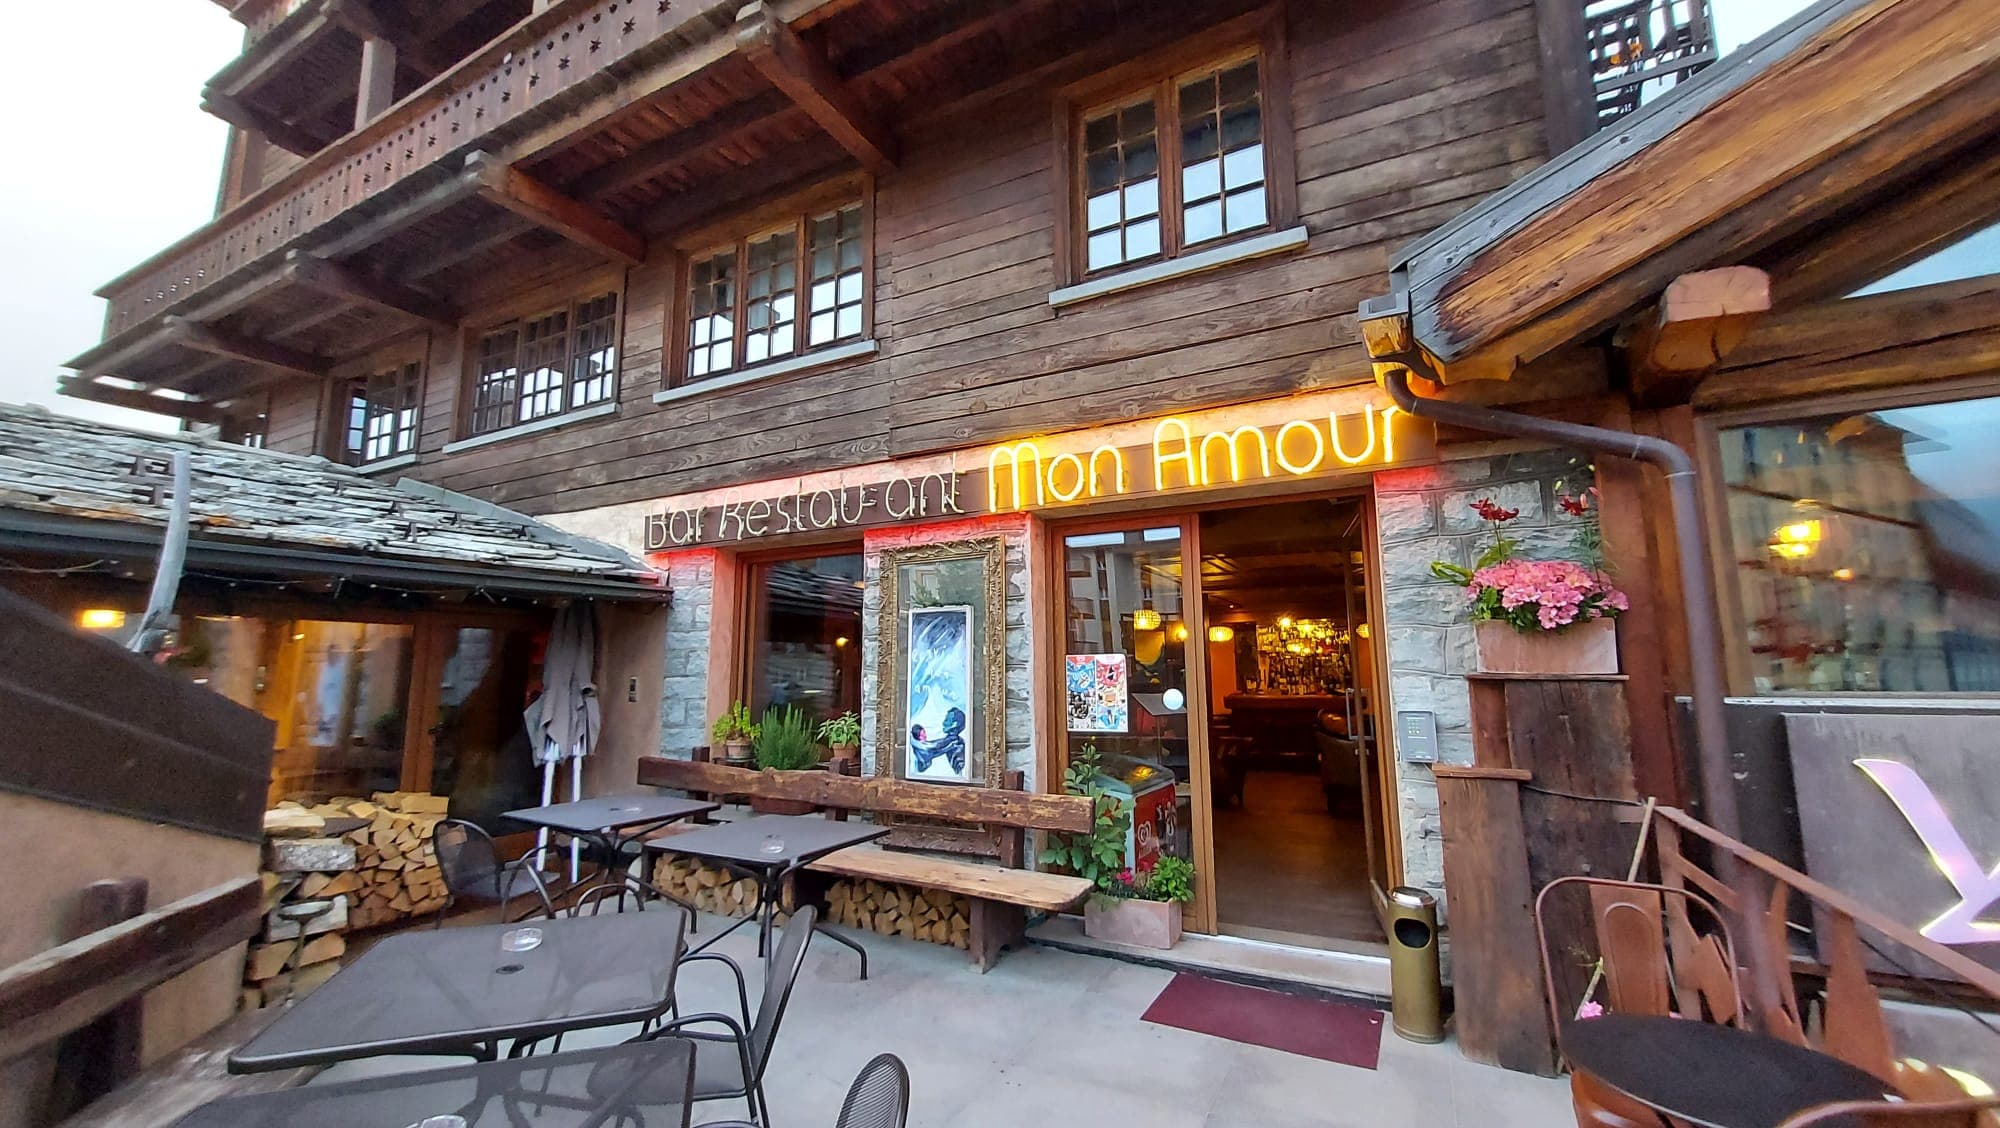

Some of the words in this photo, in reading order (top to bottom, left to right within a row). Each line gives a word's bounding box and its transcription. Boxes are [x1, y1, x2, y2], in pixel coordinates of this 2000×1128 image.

[649, 499, 707, 548] Bar
[718, 452, 965, 541] Restauant
[988, 441, 1125, 513] Mon
[1152, 403, 1402, 491] Amour
